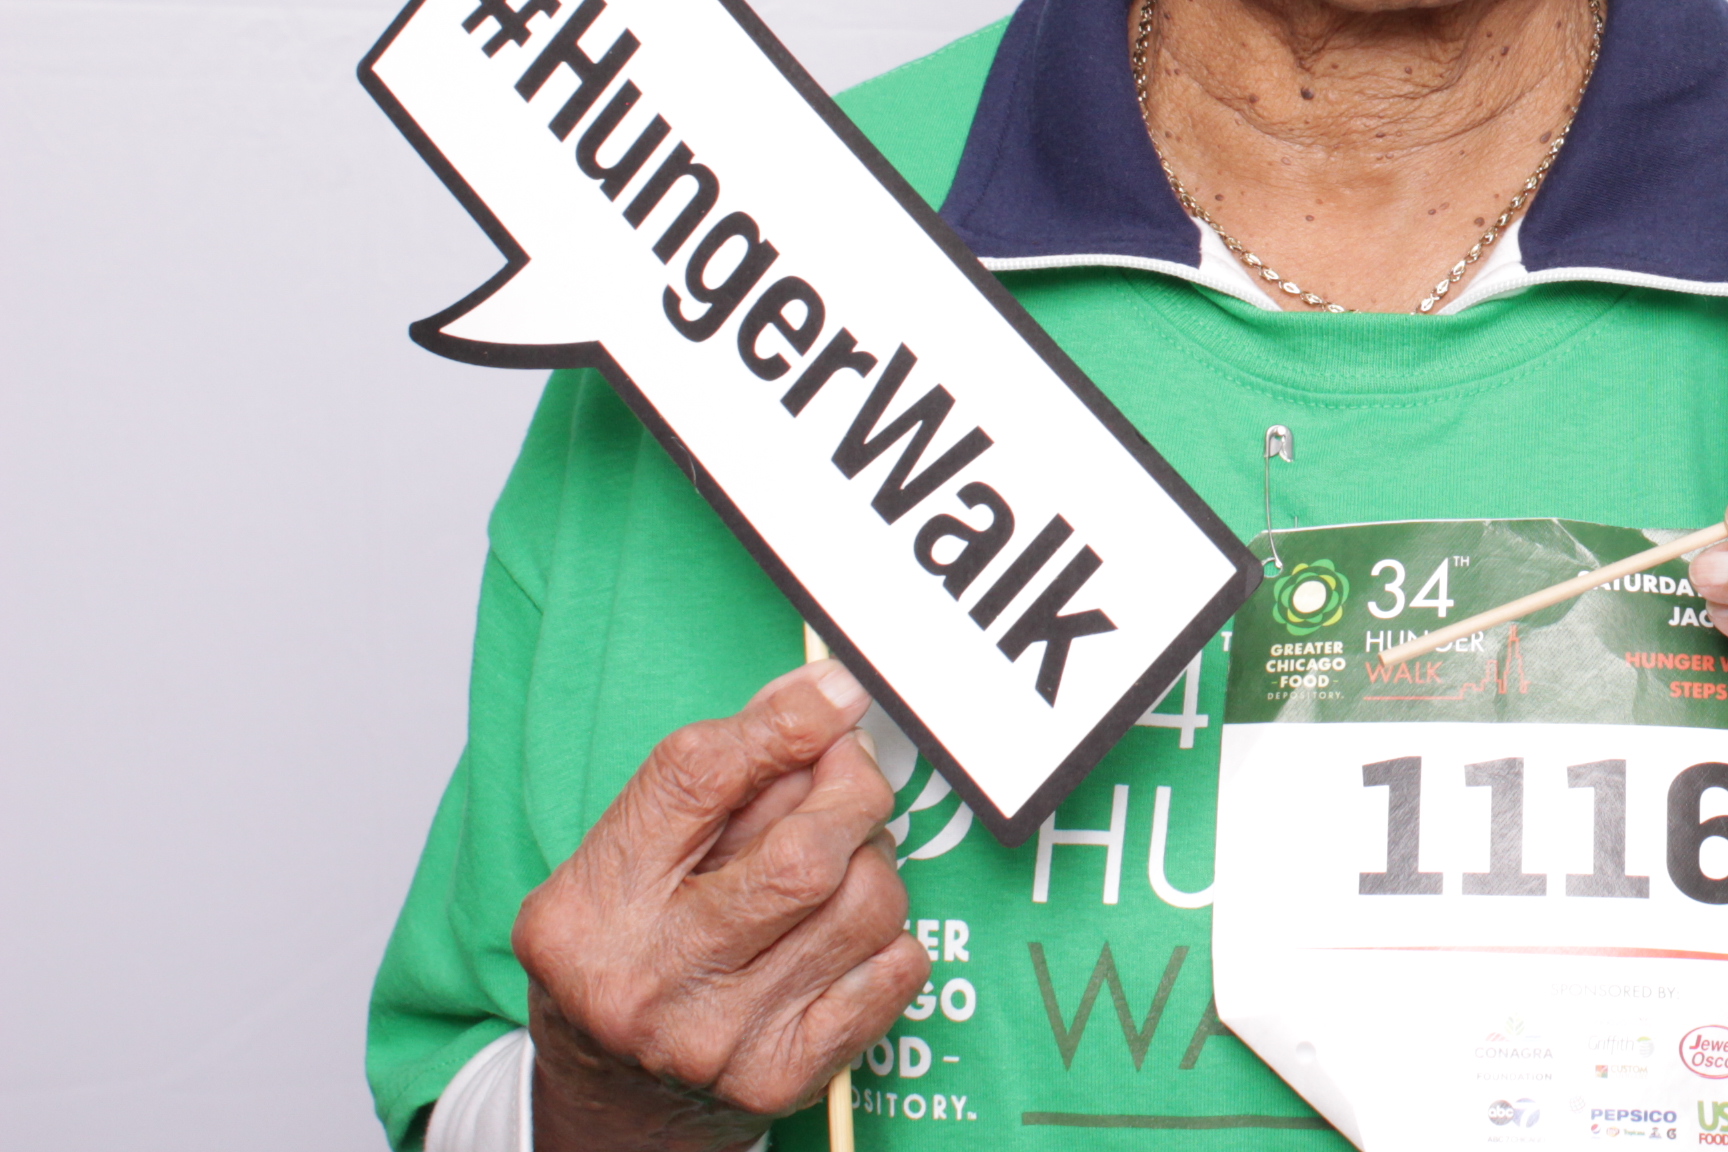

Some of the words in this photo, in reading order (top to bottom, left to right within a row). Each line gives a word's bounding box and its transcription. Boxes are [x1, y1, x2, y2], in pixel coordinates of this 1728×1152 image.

[1578, 570, 1704, 597] TURDA
[1271, 641, 1344, 656] GREATER
[1266, 658, 1346, 673] CHICAGO
[1625, 651, 1716, 672] HUNGER
[1365, 661, 1444, 684] WALK
[1669, 680, 1728, 701] STEPS
[1551, 983, 1652, 998] SPONSORED
[1588, 1035, 1634, 1055] Griffith
[1475, 1047, 1553, 1059] CONAGRA
[1476, 1073, 1553, 1081] FOUNDATION
[1611, 1065, 1648, 1074] CUSTOM
[1488, 1104, 1514, 1118] abc
[1590, 1108, 1677, 1124] PEPSICO
